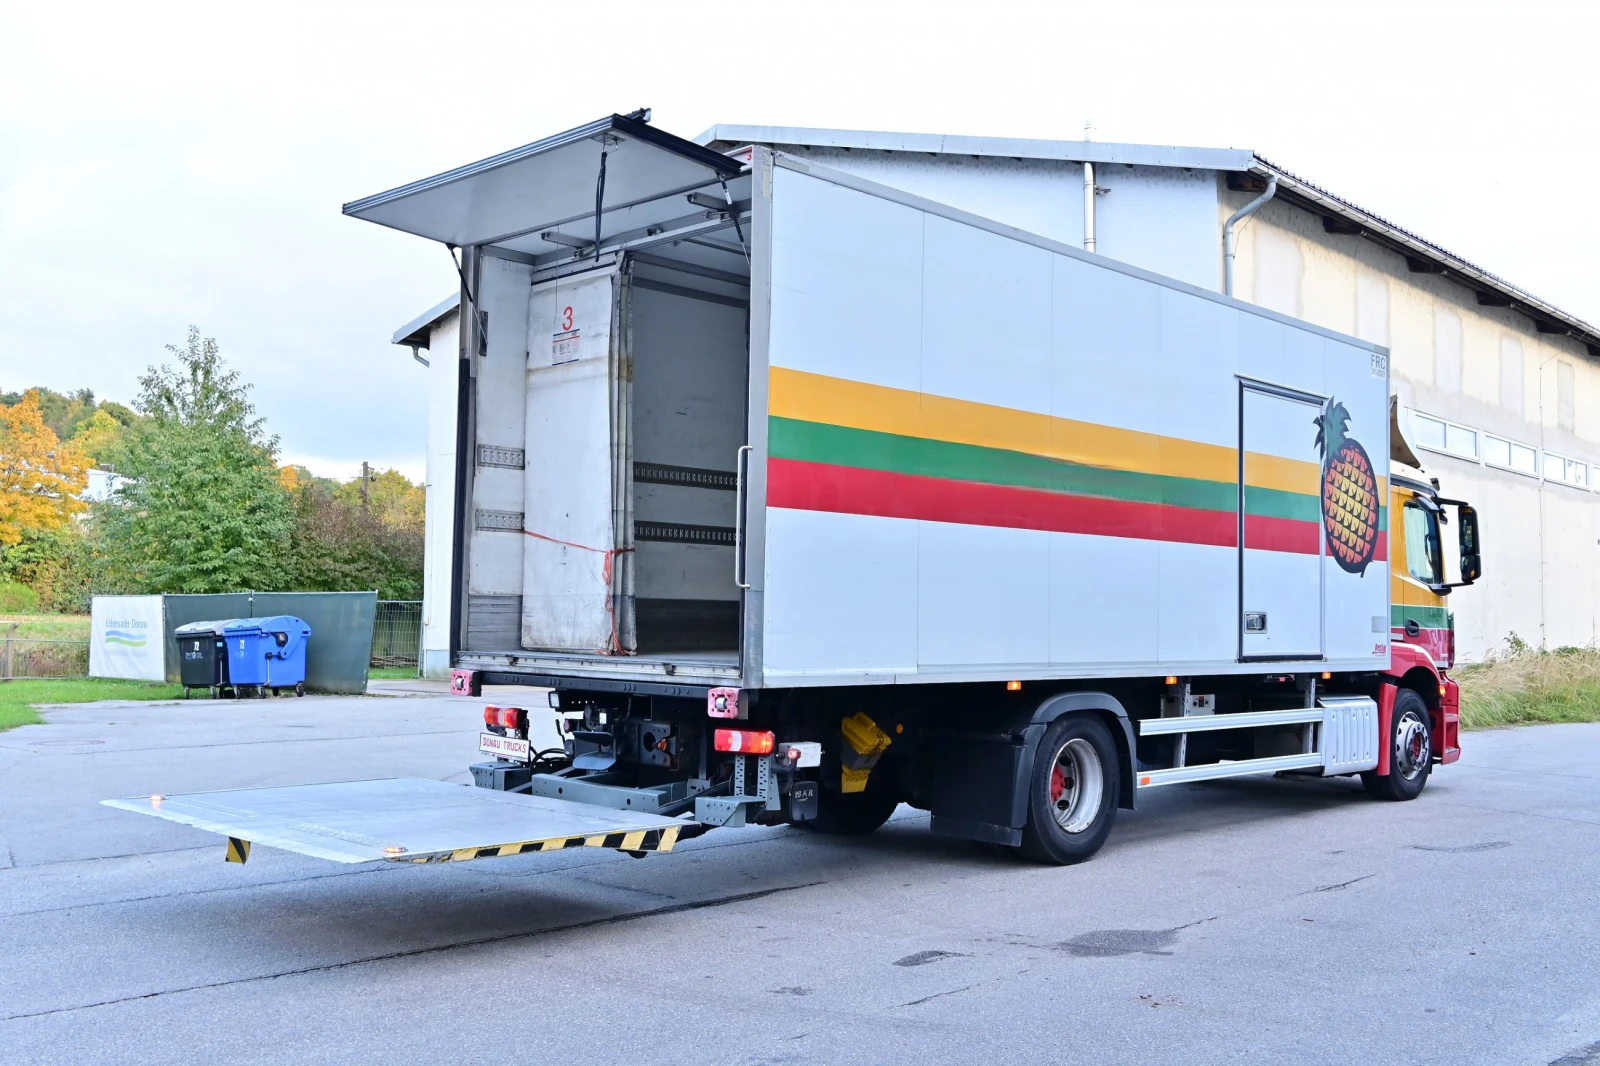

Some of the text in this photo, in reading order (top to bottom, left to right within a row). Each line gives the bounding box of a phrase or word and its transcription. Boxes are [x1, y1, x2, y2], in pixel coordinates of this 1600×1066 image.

[562, 306, 573, 331] 3
[1371, 354, 1385, 370] FRC
[131, 618, 148, 628] Donau
[483, 737, 527, 753] DONAU TRUCKS
